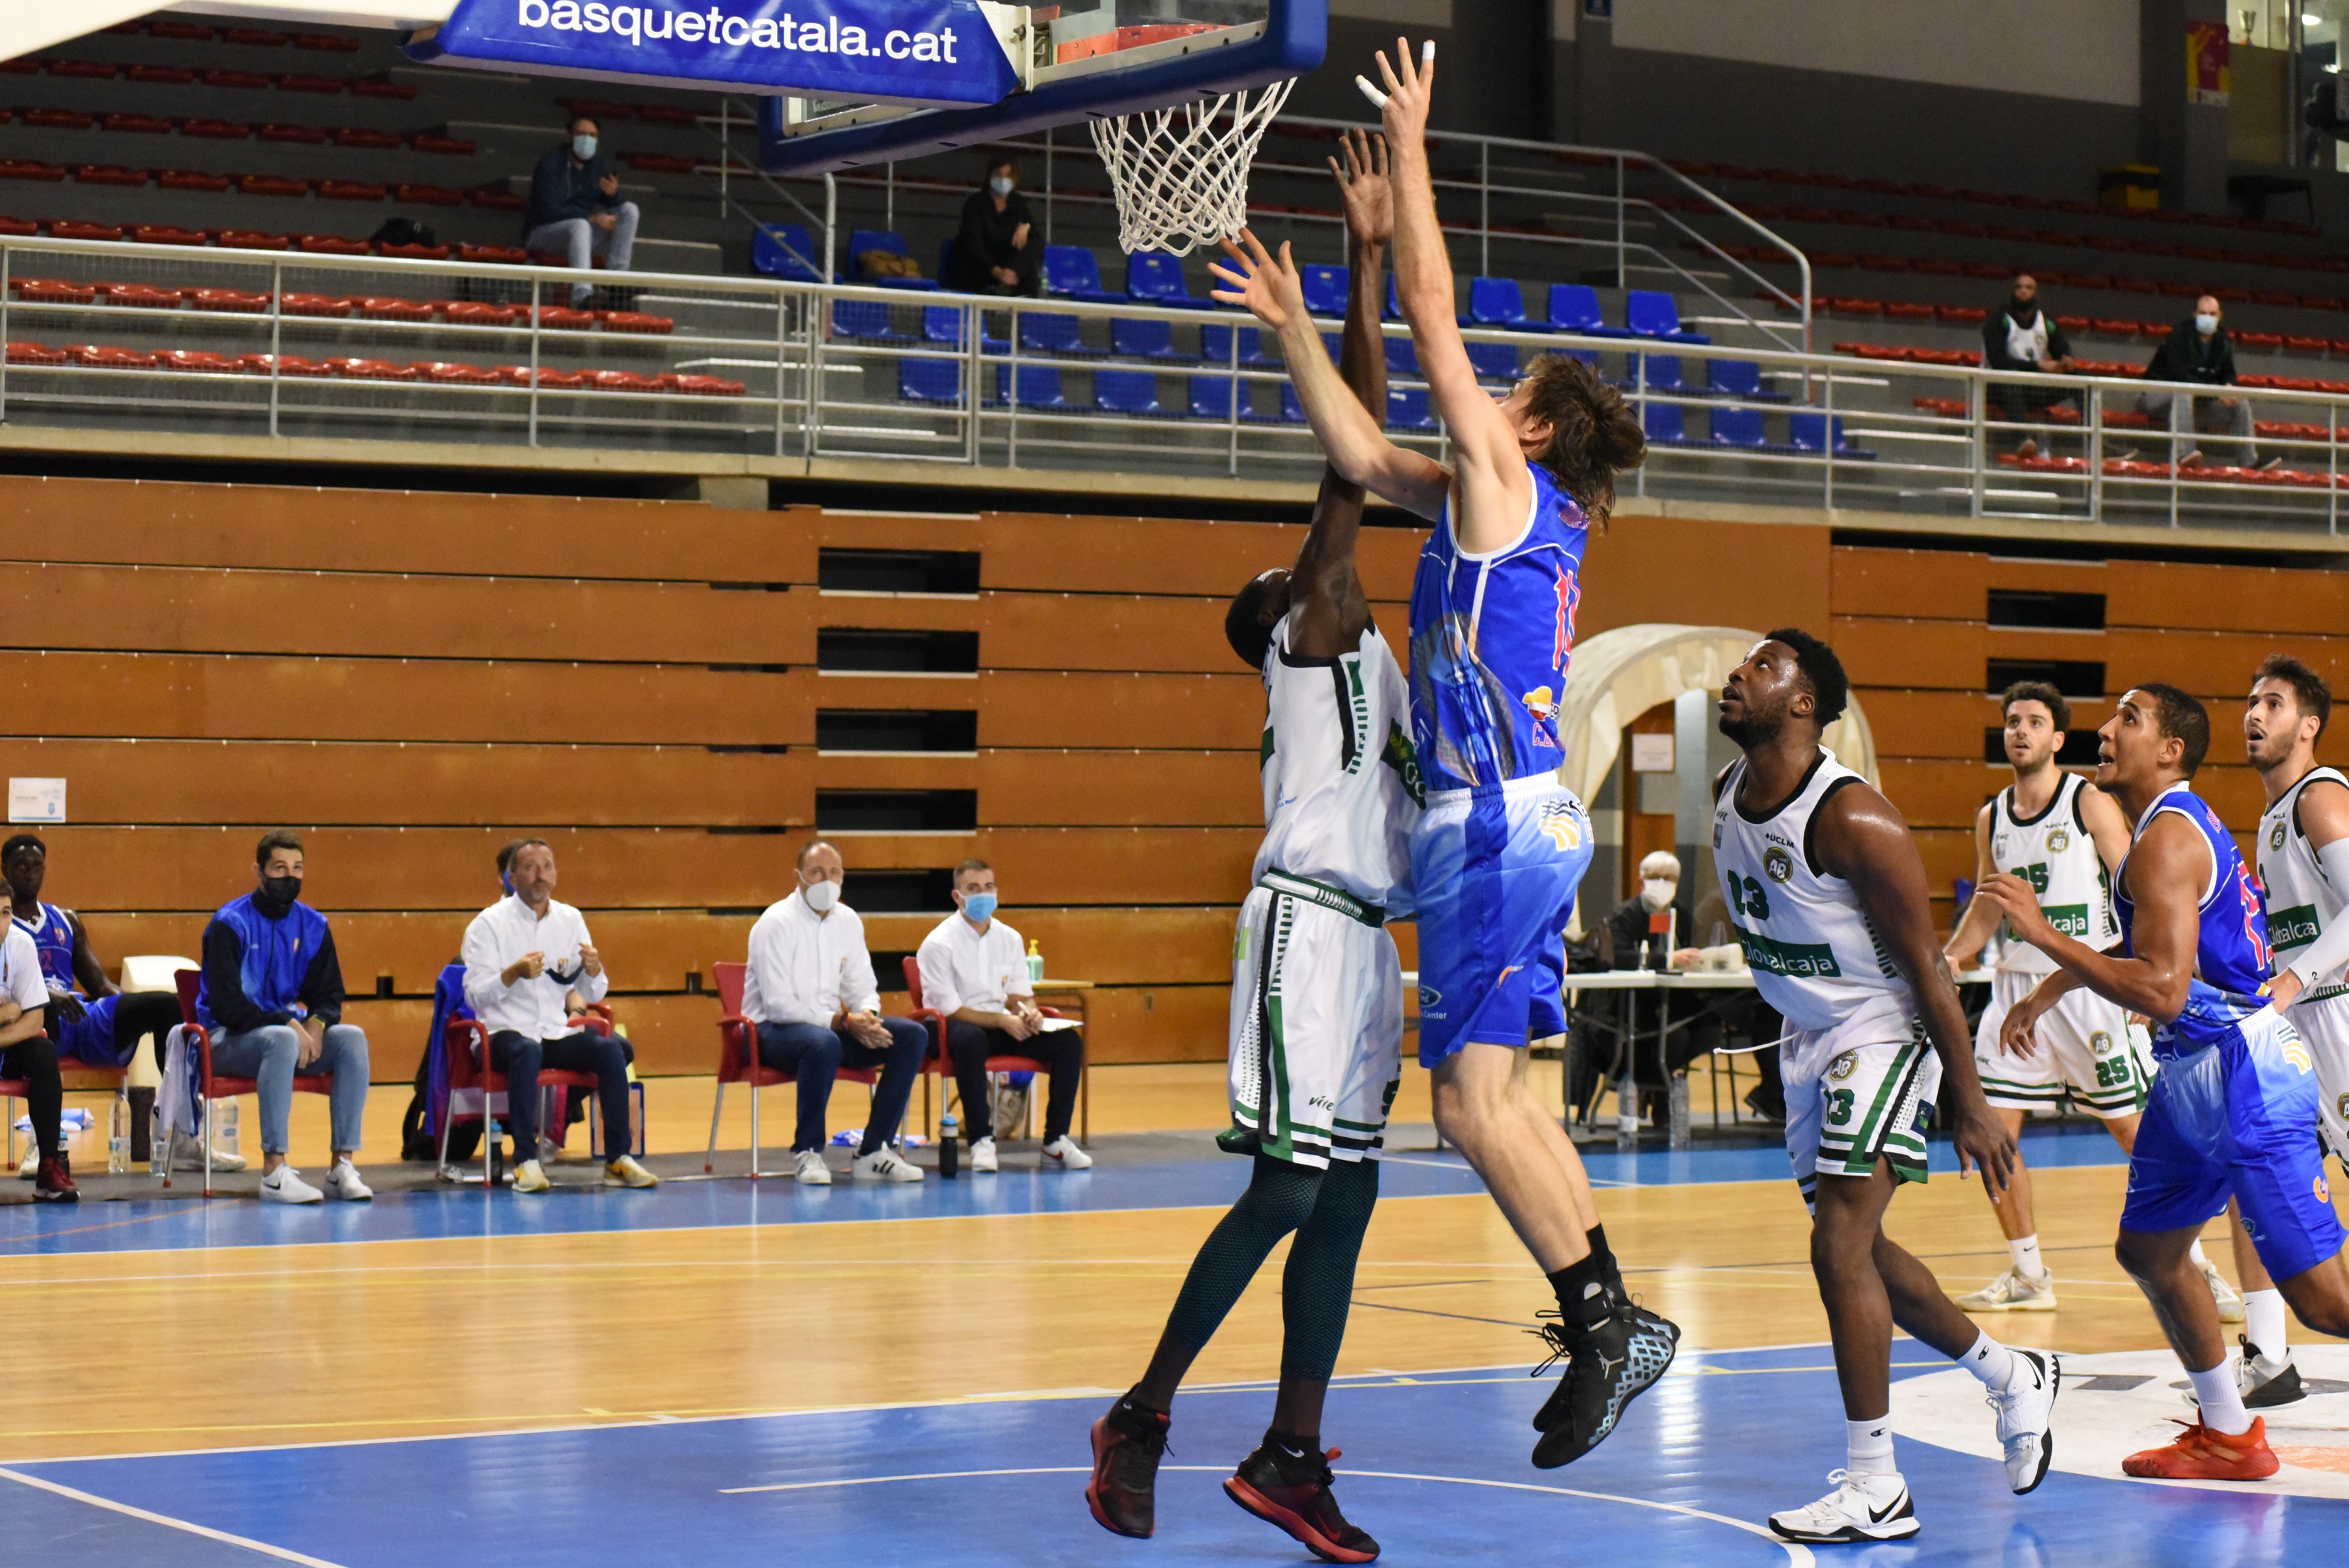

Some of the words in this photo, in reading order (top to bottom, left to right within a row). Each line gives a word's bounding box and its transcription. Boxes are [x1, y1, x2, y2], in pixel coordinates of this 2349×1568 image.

[519, 0, 957, 63] basquetcatala.cat
[1770, 833, 1795, 848] UCLM
[1768, 858, 1787, 879] AB
[1728, 869, 1770, 921] 13
[1424, 1011, 1447, 1020] Center
[2095, 1038, 2110, 1052] AB
[1832, 1059, 1851, 1077] AB
[2095, 1055, 2131, 1087] 25
[1824, 1088, 1854, 1126] 13
